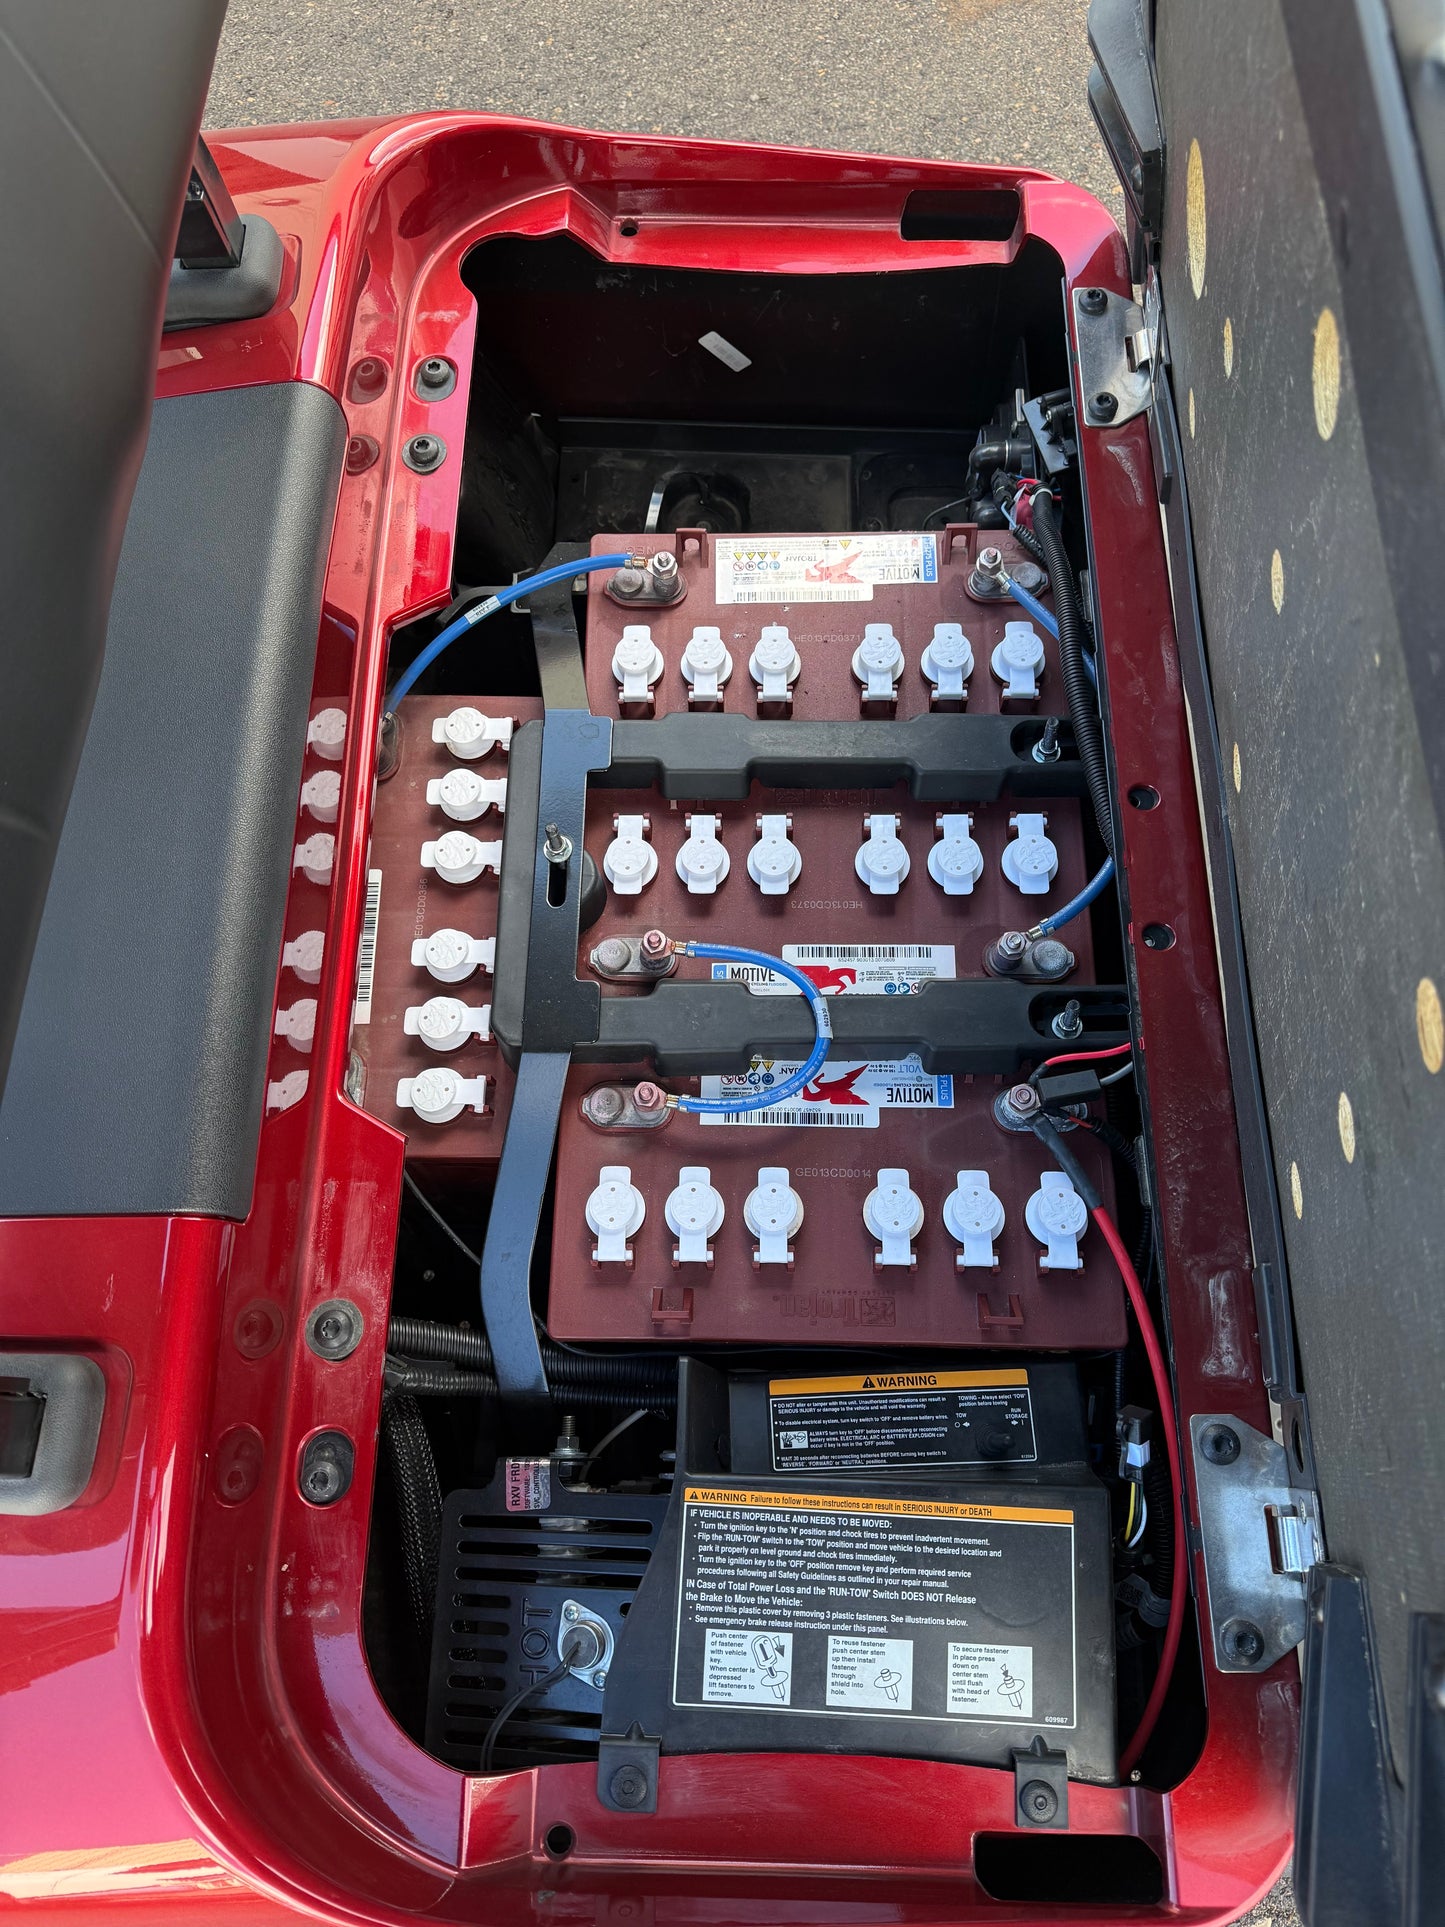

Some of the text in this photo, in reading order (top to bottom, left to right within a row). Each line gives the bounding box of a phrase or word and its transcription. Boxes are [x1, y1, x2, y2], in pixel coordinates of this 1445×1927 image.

[879, 567, 920, 581] MOTIVE
[925, 560, 933, 577] PLUS
[731, 967, 776, 982] MOTIVE
[898, 1064, 922, 1073] VOLT
[886, 1087, 934, 1103] MOTIVE
[941, 1079, 949, 1100] PLUS
[795, 1167, 872, 1179] GE013CD0014
[876, 1374, 937, 1388] WARNING
[511, 1458, 520, 1506] RXV FRD
[701, 1491, 747, 1503] WARNING
[750, 1494, 773, 1504] Failure
[773, 1496, 781, 1504] to
[781, 1496, 802, 1505] follow
[802, 1497, 821, 1507] these
[821, 1498, 861, 1509] instructions
[861, 1502, 874, 1510] can
[874, 1502, 894, 1511] result
[894, 1502, 901, 1511] in
[902, 1503, 933, 1513] SERIOUS
[933, 1505, 959, 1515] INJURY
[968, 1507, 992, 1517] DEATH
[690, 1508, 892, 1529] IF VEHICLE IS INOPERABLE AND NEEDS TO BE MOVED:
[700, 1520, 716, 1530] Turn
[717, 1522, 728, 1531] the
[729, 1522, 755, 1533] ignition
[755, 1524, 768, 1535] key
[769, 1525, 777, 1533] to
[777, 1525, 789, 1534] the
[799, 1527, 827, 1536] position
[827, 1529, 841, 1537] and
[841, 1529, 863, 1538] chock
[863, 1530, 879, 1539] tires
[879, 1532, 887, 1540] to
[888, 1533, 914, 1542] prevent
[915, 1533, 953, 1544] inadvertent
[953, 1537, 990, 1546] movement.
[697, 1531, 711, 1542] Flip
[711, 1533, 723, 1542] the
[761, 1536, 784, 1545] switch
[784, 1537, 792, 1545] to
[793, 1537, 805, 1546] the
[826, 1540, 854, 1549] position
[854, 1541, 868, 1550] and
[869, 1543, 888, 1551] move
[888, 1543, 913, 1553] vehicle
[914, 1545, 922, 1553] to
[922, 1545, 934, 1554] the
[934, 1546, 960, 1555] desired
[961, 1547, 988, 1557] location
[989, 1549, 1002, 1558] and
[698, 1544, 898, 1564] park it properly on level ground and chock tires immediately.
[685, 1591, 803, 1607] the Brake to Move the Vehicle:
[686, 1578, 695, 1588] IN
[696, 1579, 717, 1590] Case
[717, 1580, 726, 1590] of
[727, 1580, 748, 1591] Total
[749, 1582, 774, 1593] Power
[775, 1583, 795, 1594] Loss
[796, 1585, 812, 1595] and
[813, 1586, 826, 1596] the
[872, 1589, 899, 1600] Switch
[901, 1591, 925, 1602] DOES
[926, 1592, 944, 1602] NOT
[945, 1593, 977, 1605] Release
[694, 1614, 889, 1635] See emergency brake release instruction under this panel.
[711, 1631, 727, 1639] Push
[518, 1596, 553, 1695] HOT
[718, 1640, 744, 1648] fastener
[984, 1647, 1010, 1655] fastener
